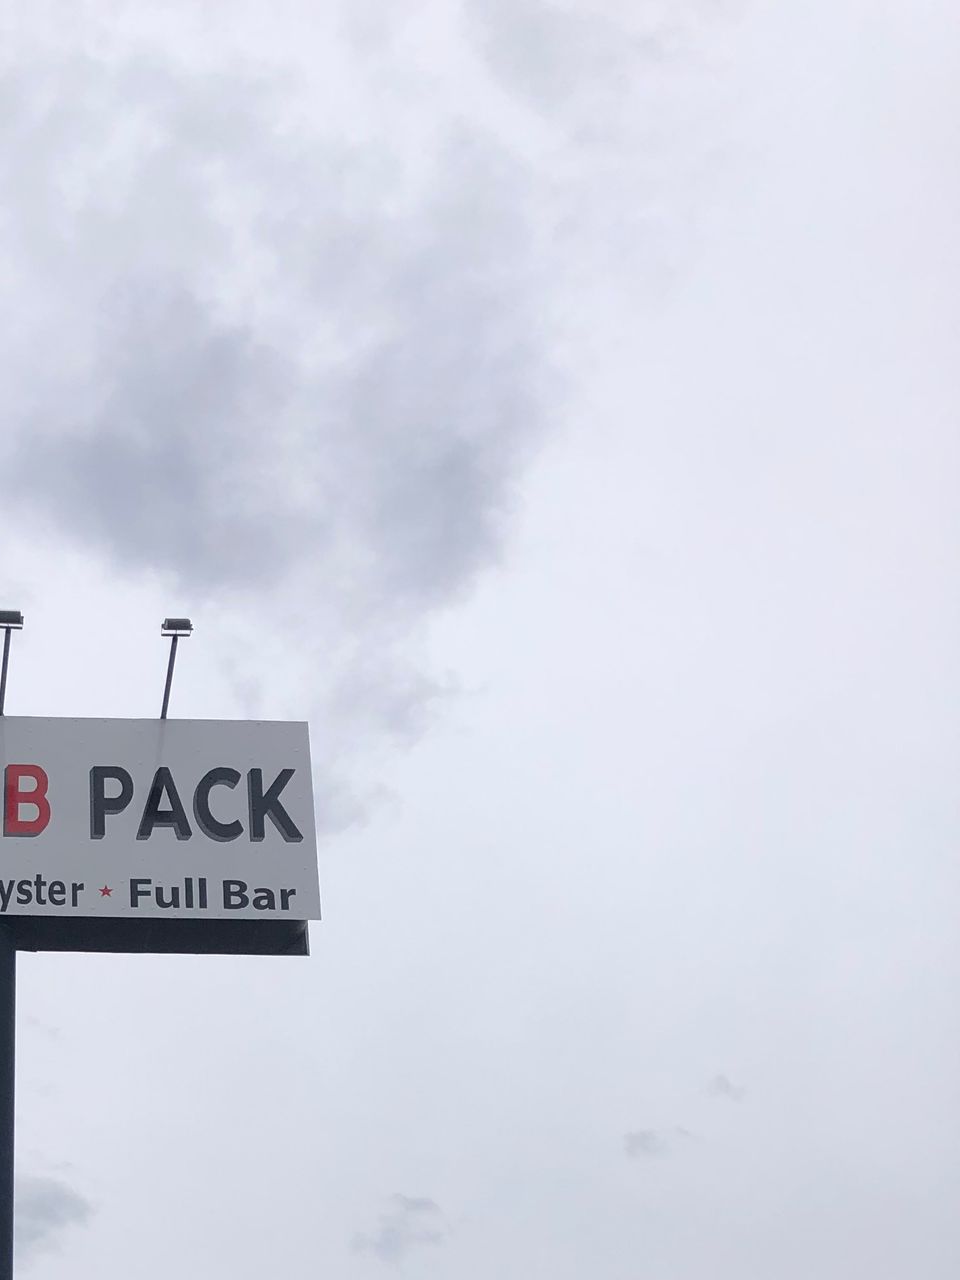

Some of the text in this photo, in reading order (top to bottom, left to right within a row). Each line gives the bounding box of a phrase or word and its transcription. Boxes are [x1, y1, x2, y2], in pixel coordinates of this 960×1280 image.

[89, 766, 304, 843] PACK
[129, 877, 208, 909] Full
[222, 879, 296, 911] Bar
